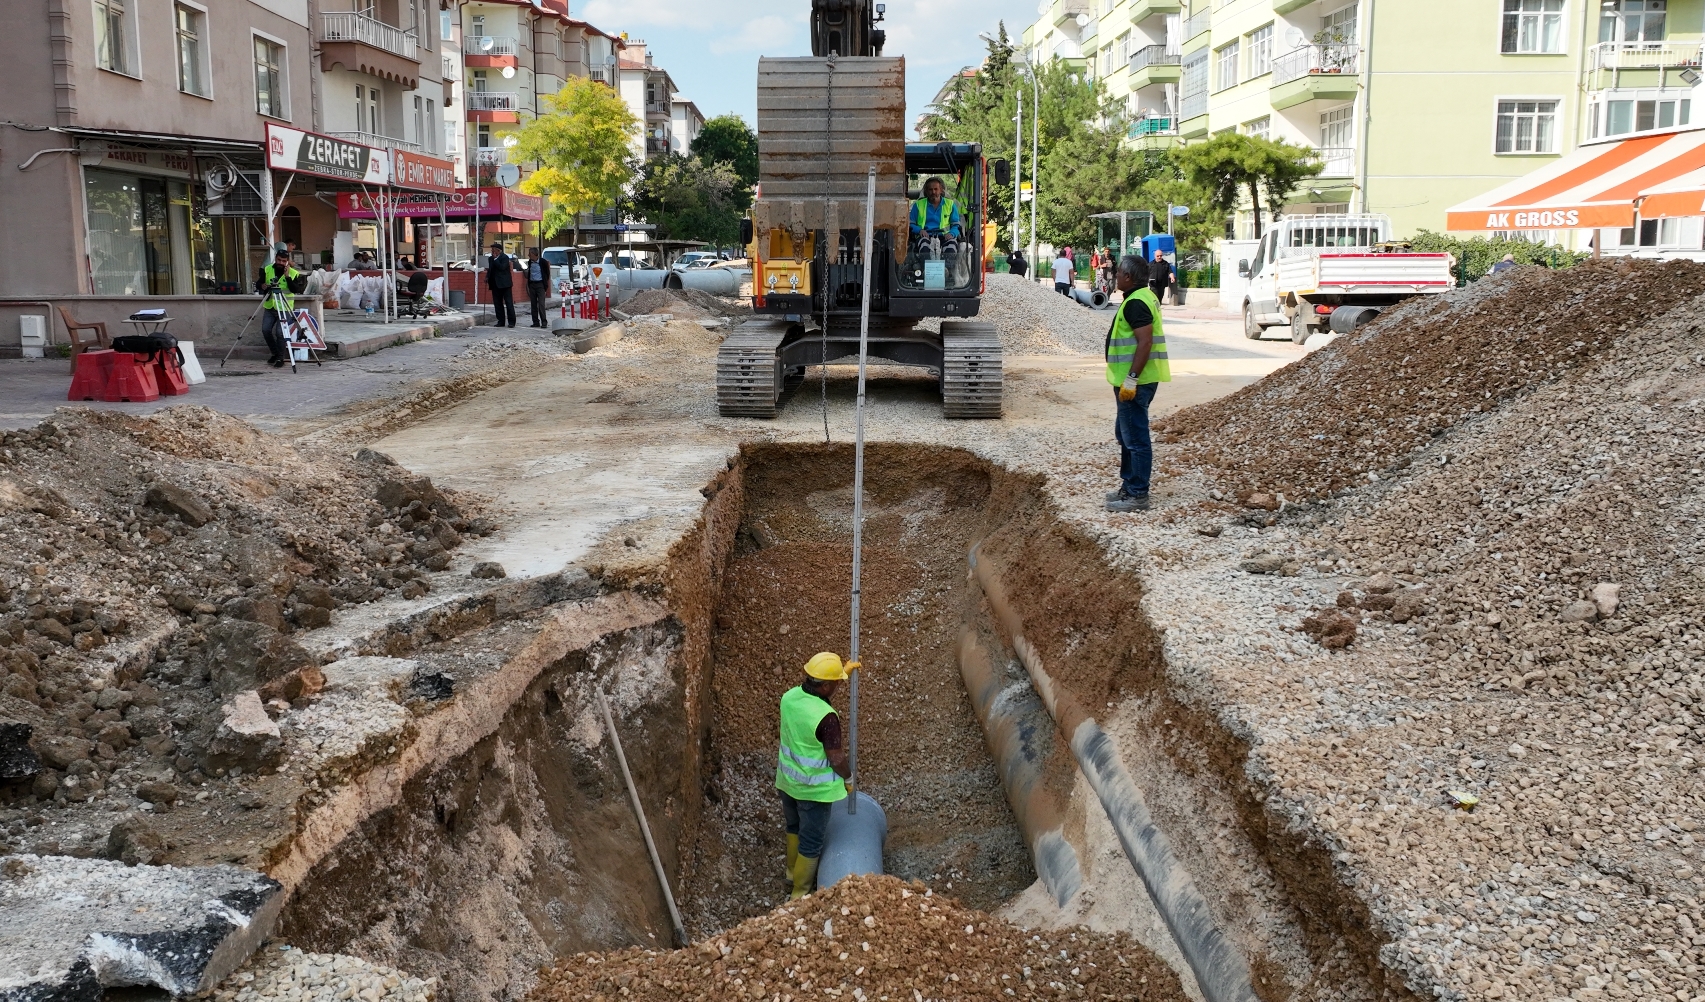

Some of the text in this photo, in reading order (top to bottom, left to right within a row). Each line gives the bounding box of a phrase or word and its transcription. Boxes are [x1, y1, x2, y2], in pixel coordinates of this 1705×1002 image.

[307, 135, 361, 169] ZERAFET
[165, 153, 192, 172] PERD
[425, 165, 433, 185] ET
[433, 166, 453, 188] MARKET
[409, 193, 435, 203] MEHMET
[435, 193, 450, 203] Uta
[1486, 209, 1579, 228] AK GROSS
